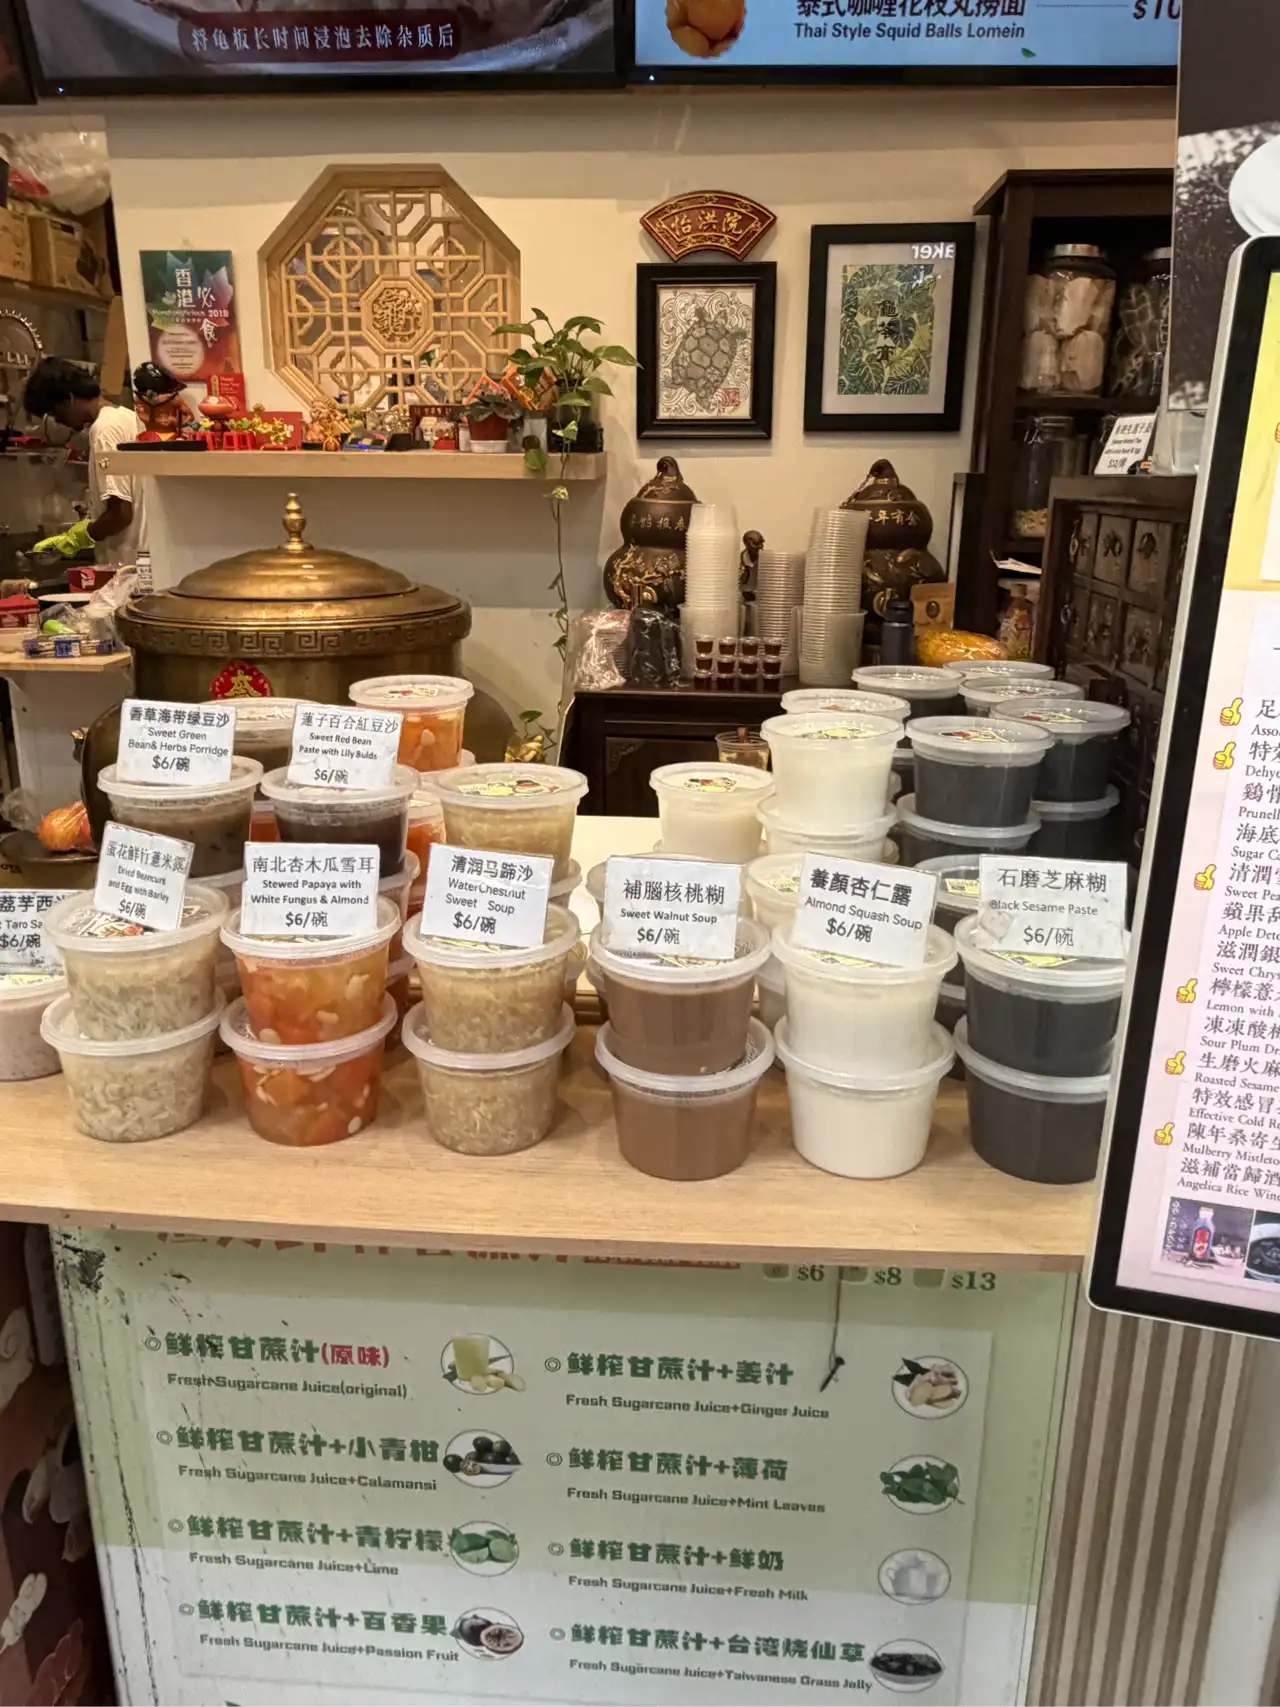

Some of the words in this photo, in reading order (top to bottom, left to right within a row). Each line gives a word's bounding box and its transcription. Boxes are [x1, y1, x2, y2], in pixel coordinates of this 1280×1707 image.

[795, 23, 827, 38] Thai
[832, 23, 871, 41] Style
[876, 23, 921, 41] Squid
[925, 24, 962, 39] Balls
[966, 24, 1025, 39] Lomein
[175, 268, 197, 309] 香港
[300, 711, 399, 735] 蓮子百合紅豆沙
[1251, 724, 1280, 737] Asso
[148, 727, 177, 739] Sweet
[179, 730, 207, 741] Green
[309, 732, 333, 742] Sweet
[335, 734, 350, 744] Red
[352, 736, 372, 746] Bean
[128, 738, 157, 751] Bean&
[160, 742, 187, 753] Herbs
[190, 744, 229, 757] Porridge
[299, 745, 320, 754] Paste
[322, 747, 339, 756] with
[341, 749, 355, 760] Lily
[152, 754, 190, 773] $6/碗
[313, 768, 349, 785] $6/碗
[1231, 846, 1264, 862] Sugar
[118, 865, 135, 878] Dried
[252, 855, 375, 875] 南北杏木瓜雪耳
[451, 854, 534, 882] 清润马蹄沙
[262, 879, 299, 890] Stewed
[301, 880, 337, 893] Papaya
[340, 879, 362, 890] with
[997, 867, 1108, 893] 石磨芝麻糊
[108, 880, 120, 889] and
[121, 882, 133, 894] Egg
[148, 890, 169, 904] Barley
[251, 894, 281, 905] White
[282, 895, 318, 908] Fungus
[320, 895, 329, 905] &
[330, 894, 370, 905] Almond
[622, 878, 725, 906] 補腦核桃糊
[1224, 886, 1257, 899] Sweet
[119, 898, 147, 920] $6/碗
[445, 893, 478, 908] Sweet
[487, 900, 515, 916] Soup
[805, 896, 846, 914] Almond
[848, 905, 890, 923] Squash
[892, 914, 923, 932] Soup
[989, 899, 1019, 911] Black
[1022, 901, 1065, 914] Sesame
[1068, 904, 1098, 916] Paste
[5, 919, 28, 929] Taro
[284, 911, 329, 929] $6/碗
[453, 911, 497, 935] $6/碗
[620, 908, 651, 919] Sweet
[653, 910, 690, 922] Walnut
[691, 913, 718, 925] Soup
[637, 927, 680, 945] $6/碗
[825, 916, 873, 943] $6/碗
[1023, 925, 1074, 947] $6/碗
[1218, 924, 1252, 940] Apple
[1211, 962, 1244, 976] Sweet
[1209, 977, 1280, 1002] 檸檬薏
[1206, 1000, 1244, 1014] Lemon
[1249, 1004, 1274, 1018] with
[1199, 1035, 1226, 1048] Sour
[1230, 1039, 1259, 1053] Plum
[1194, 1072, 1236, 1087] Roasted
[1240, 1079, 1279, 1094] Sesame
[1192, 1087, 1280, 1115] 特效感冒
[1188, 1107, 1234, 1123] Effective
[1238, 1113, 1265, 1128] Cold
[1182, 1143, 1232, 1161] Mulberry
[1177, 1176, 1222, 1193] Angelica
[1226, 1184, 1249, 1197] Rice
[797, 1264, 825, 1282] $6
[874, 1267, 902, 1286] $8
[951, 1271, 997, 1291] $13
[164, 1332, 391, 1369] 鲜榨甘蔗汁(原味)
[568, 1352, 794, 1386] 鲜榨甘蔗汁+姜汁
[302, 1381, 408, 1399] Juice(original)
[566, 1394, 608, 1407] Fresh
[612, 1397, 690, 1413] Sugarcane
[694, 1401, 789, 1420] Juice+Ginger
[792, 1407, 830, 1419] Juice
[176, 1425, 440, 1464] 鲜榨甘蔗汁+小青柑
[568, 1447, 789, 1483] 鲜榨甘蔗汁+薄荷
[178, 1465, 222, 1479] Fresh
[226, 1468, 306, 1485] Sugarcane
[310, 1472, 437, 1492] Juice+Calamansi
[567, 1487, 608, 1501] Fresh
[612, 1490, 689, 1507] Sugarcane
[692, 1493, 770, 1511] Juice+Mint
[773, 1500, 826, 1514] Leaves
[187, 1514, 444, 1553] 鲜榨甘蔗汁+青柠檬
[189, 1552, 231, 1566] Fresh
[235, 1555, 314, 1571] Sugarcane
[318, 1560, 399, 1576] Juice+Lime
[569, 1538, 784, 1572] 鲜榨甘蔗汁+鲜奶
[568, 1575, 608, 1589] Fresh
[611, 1577, 688, 1594] Sugarcane
[690, 1583, 775, 1600] Juice+Fresh
[778, 1588, 809, 1601] Milk
[198, 1599, 448, 1638] 鲜榨甘蔗汁+百香果
[200, 1634, 240, 1647] Fresh
[243, 1637, 318, 1653] Sugarcane
[322, 1641, 423, 1661] Juice+Passion
[426, 1650, 459, 1662] Fruit
[570, 1623, 866, 1664] 鲜榨甘蔗汁+台湾烧仙草
[569, 1658, 607, 1672] Fresh
[610, 1661, 681, 1677] Sugarcane
[684, 1666, 797, 1687] Juice+Taiwanese
[800, 1676, 840, 1689] Grass
[843, 1679, 873, 1692] Jelly
